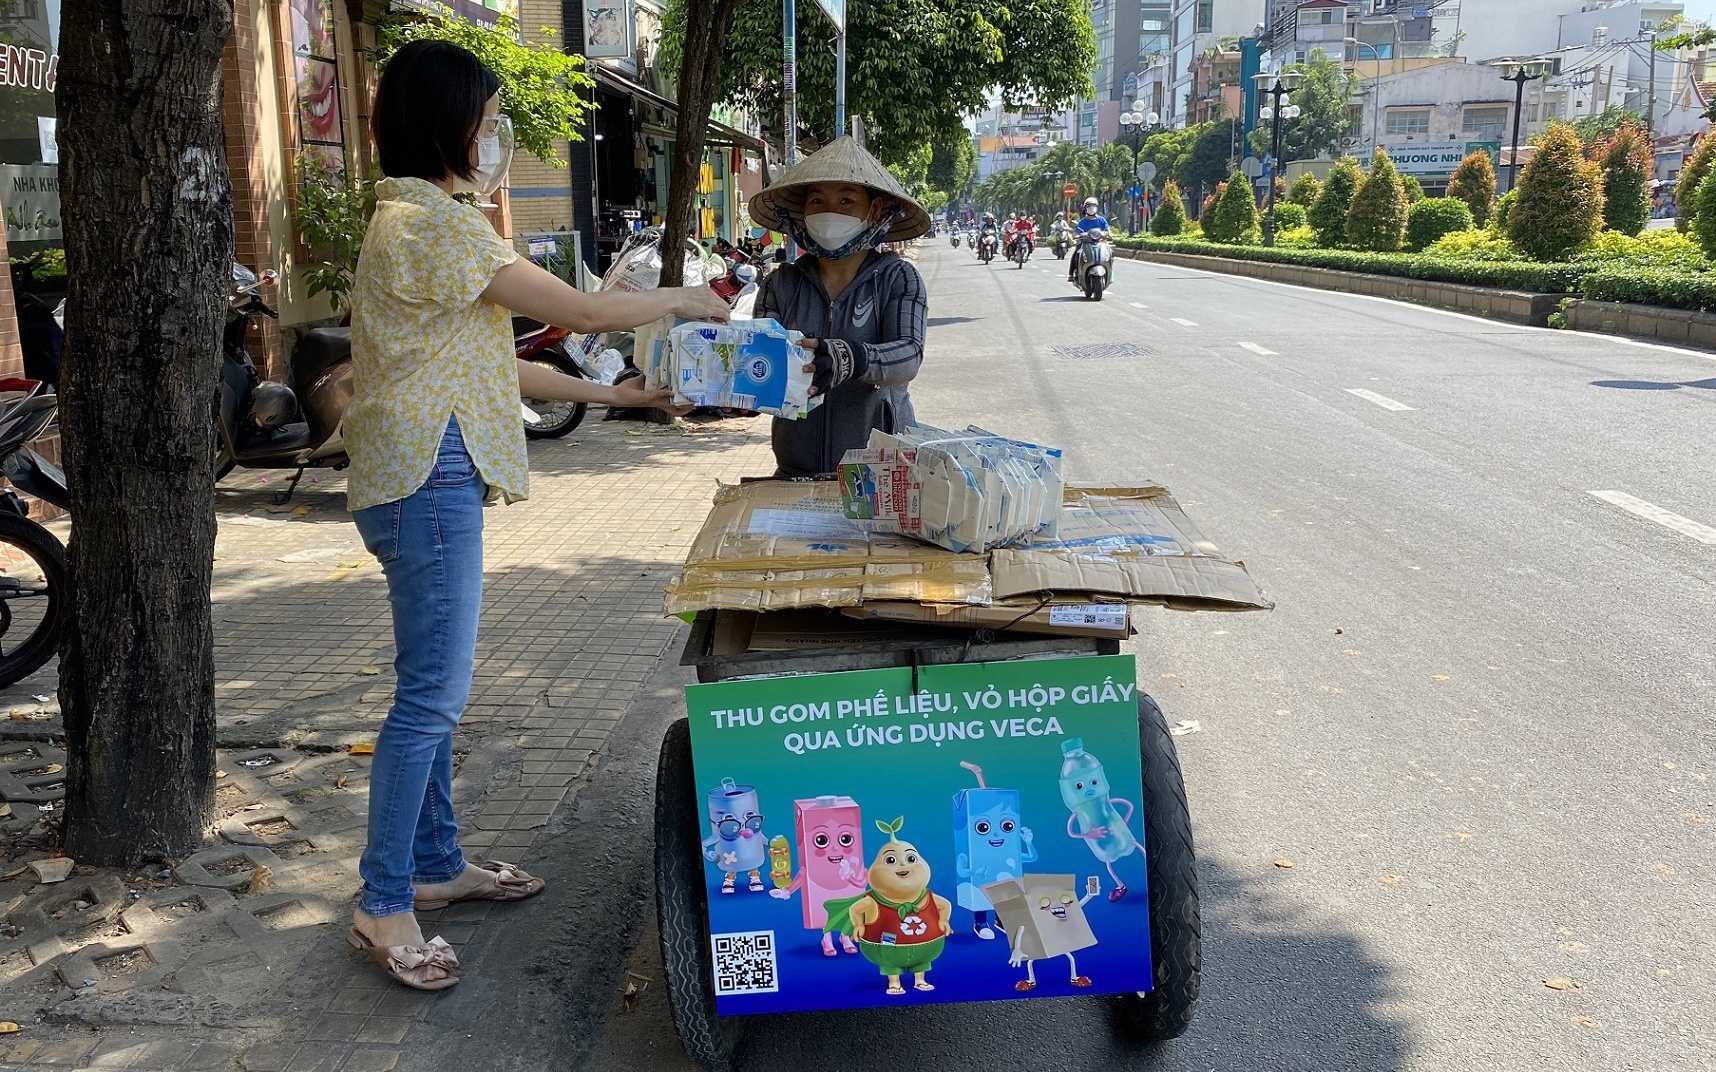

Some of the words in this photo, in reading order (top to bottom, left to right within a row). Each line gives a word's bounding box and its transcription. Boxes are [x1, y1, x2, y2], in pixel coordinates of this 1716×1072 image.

[13, 177, 37, 192] NHA
[882, 466, 891, 488] The
[883, 491, 892, 517] Milk
[710, 706, 764, 729] THU
[769, 701, 830, 724] GOM
[836, 688, 889, 719] PHẾ
[895, 688, 958, 719] LIỆU,
[962, 684, 1002, 710] VỎ
[1008, 683, 1065, 713] HỘP
[1071, 675, 1135, 705] GIẤY
[783, 730, 842, 755] QUA
[846, 723, 904, 748] ỨNG
[909, 720, 985, 748] DỤNG
[989, 716, 1064, 738] VECA
